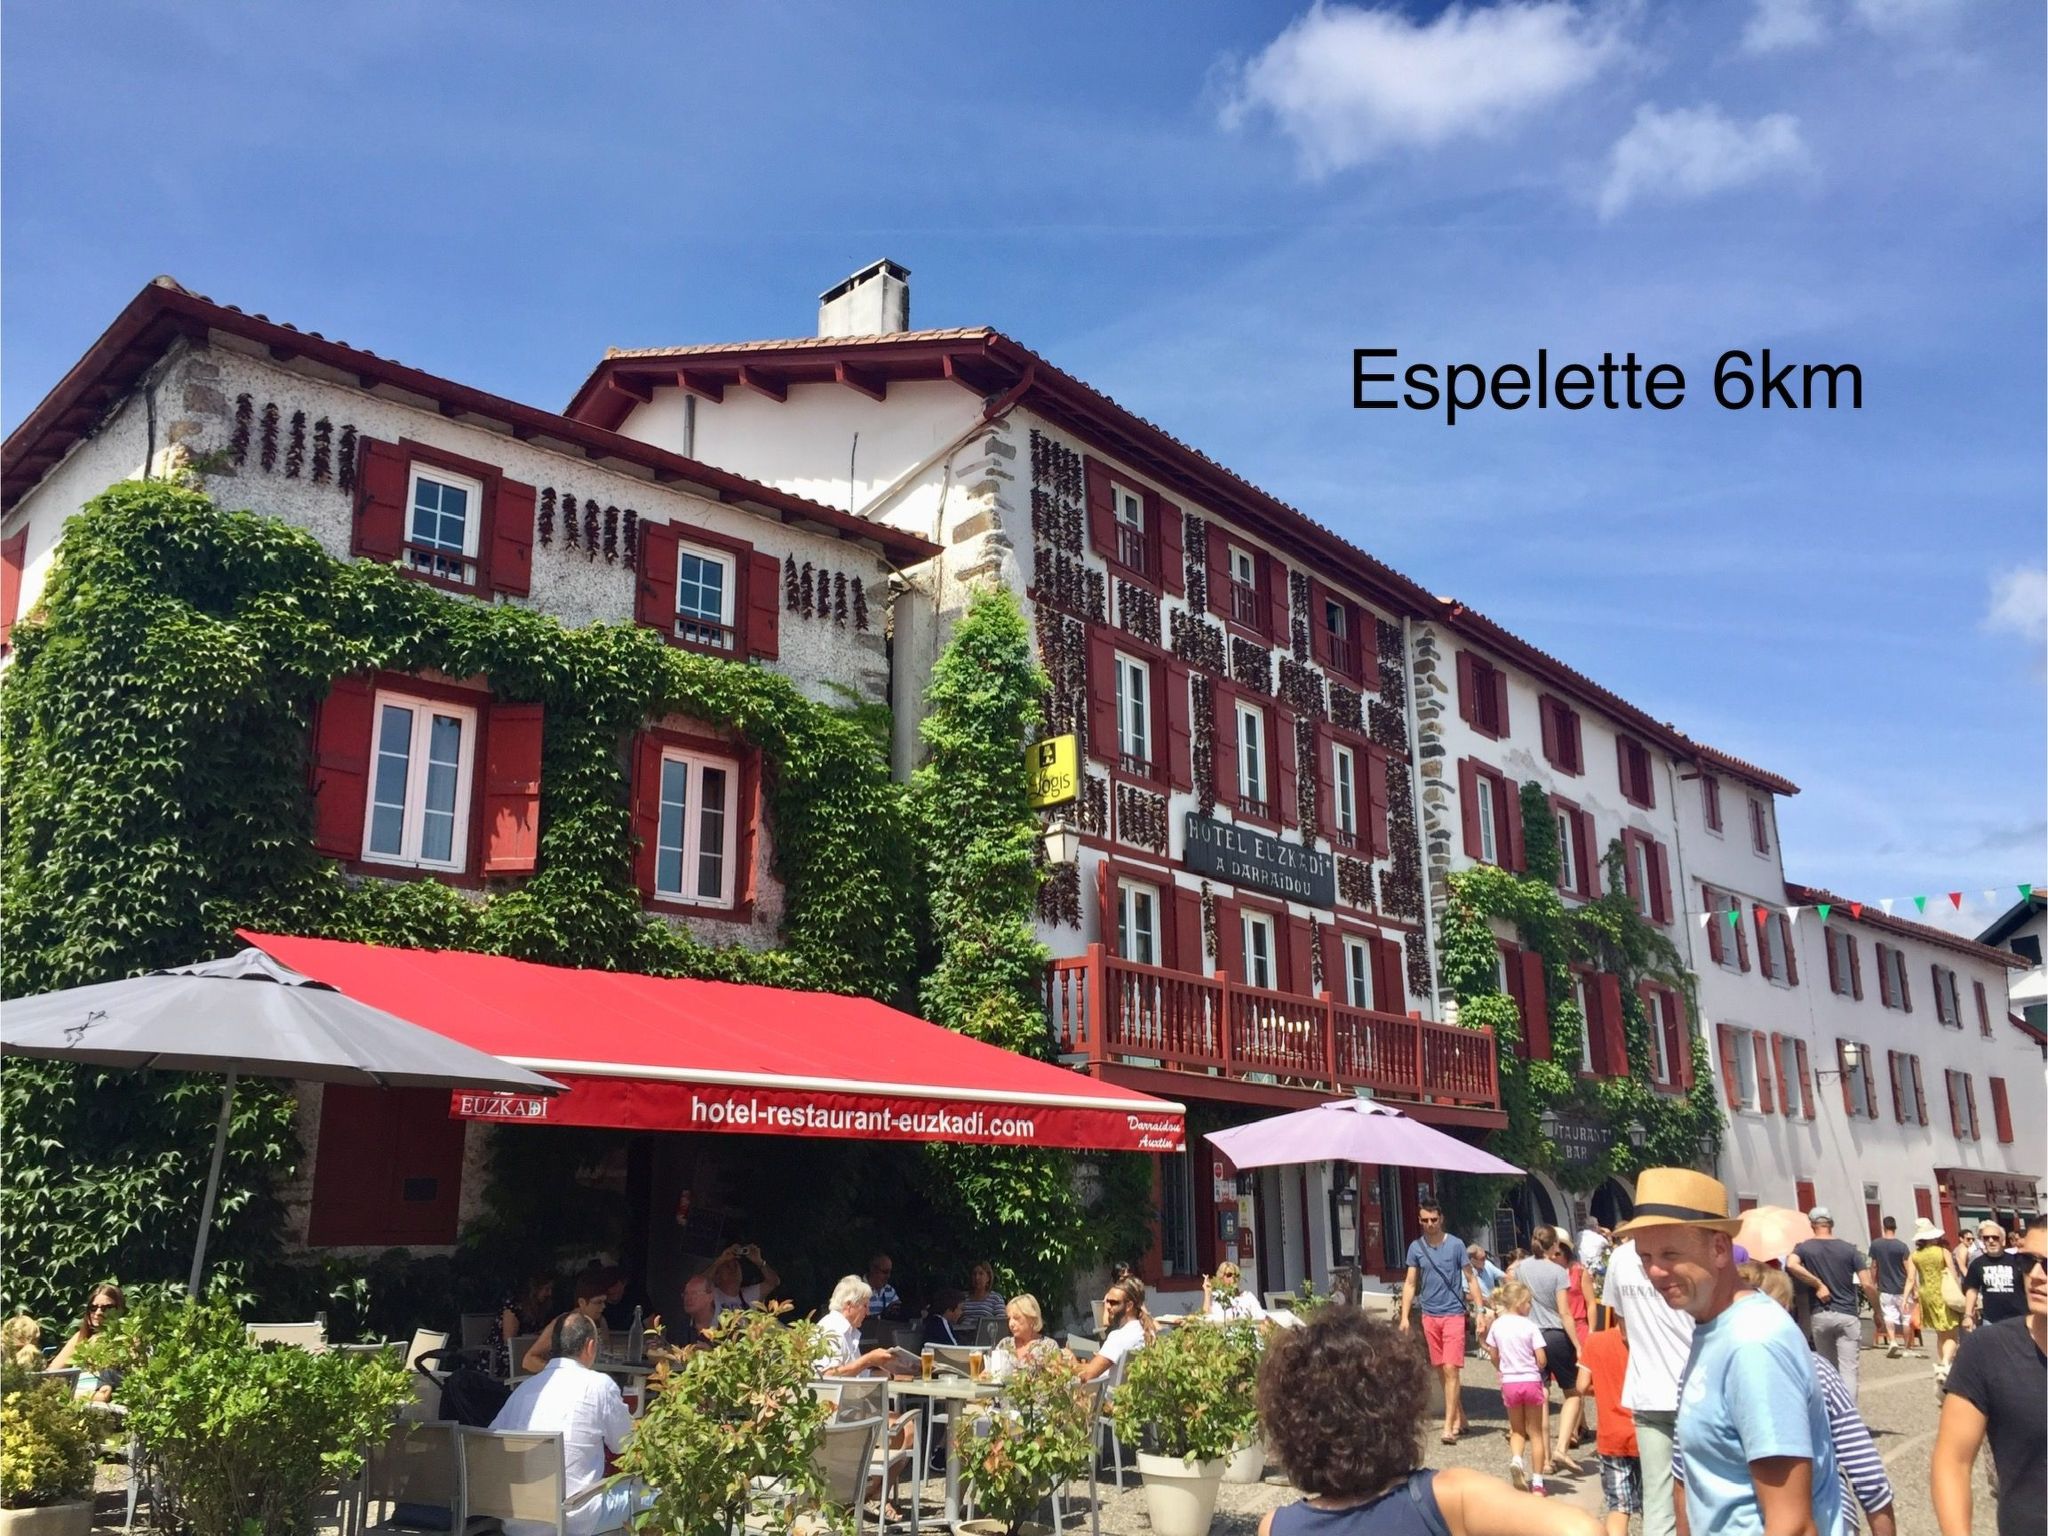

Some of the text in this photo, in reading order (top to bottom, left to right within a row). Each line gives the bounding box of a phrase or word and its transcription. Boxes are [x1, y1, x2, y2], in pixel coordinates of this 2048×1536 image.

[1028, 769, 1070, 798] Logis
[1189, 818, 1247, 854] HOTEL
[1216, 856, 1225, 872] A
[691, 1095, 1034, 1138] hotel-restaurant-euzkadi.com
[1127, 1115, 1181, 1132] Darraidou
[1558, 1125, 1608, 1143] TAURANT
[1566, 1145, 1588, 1160] BAR
